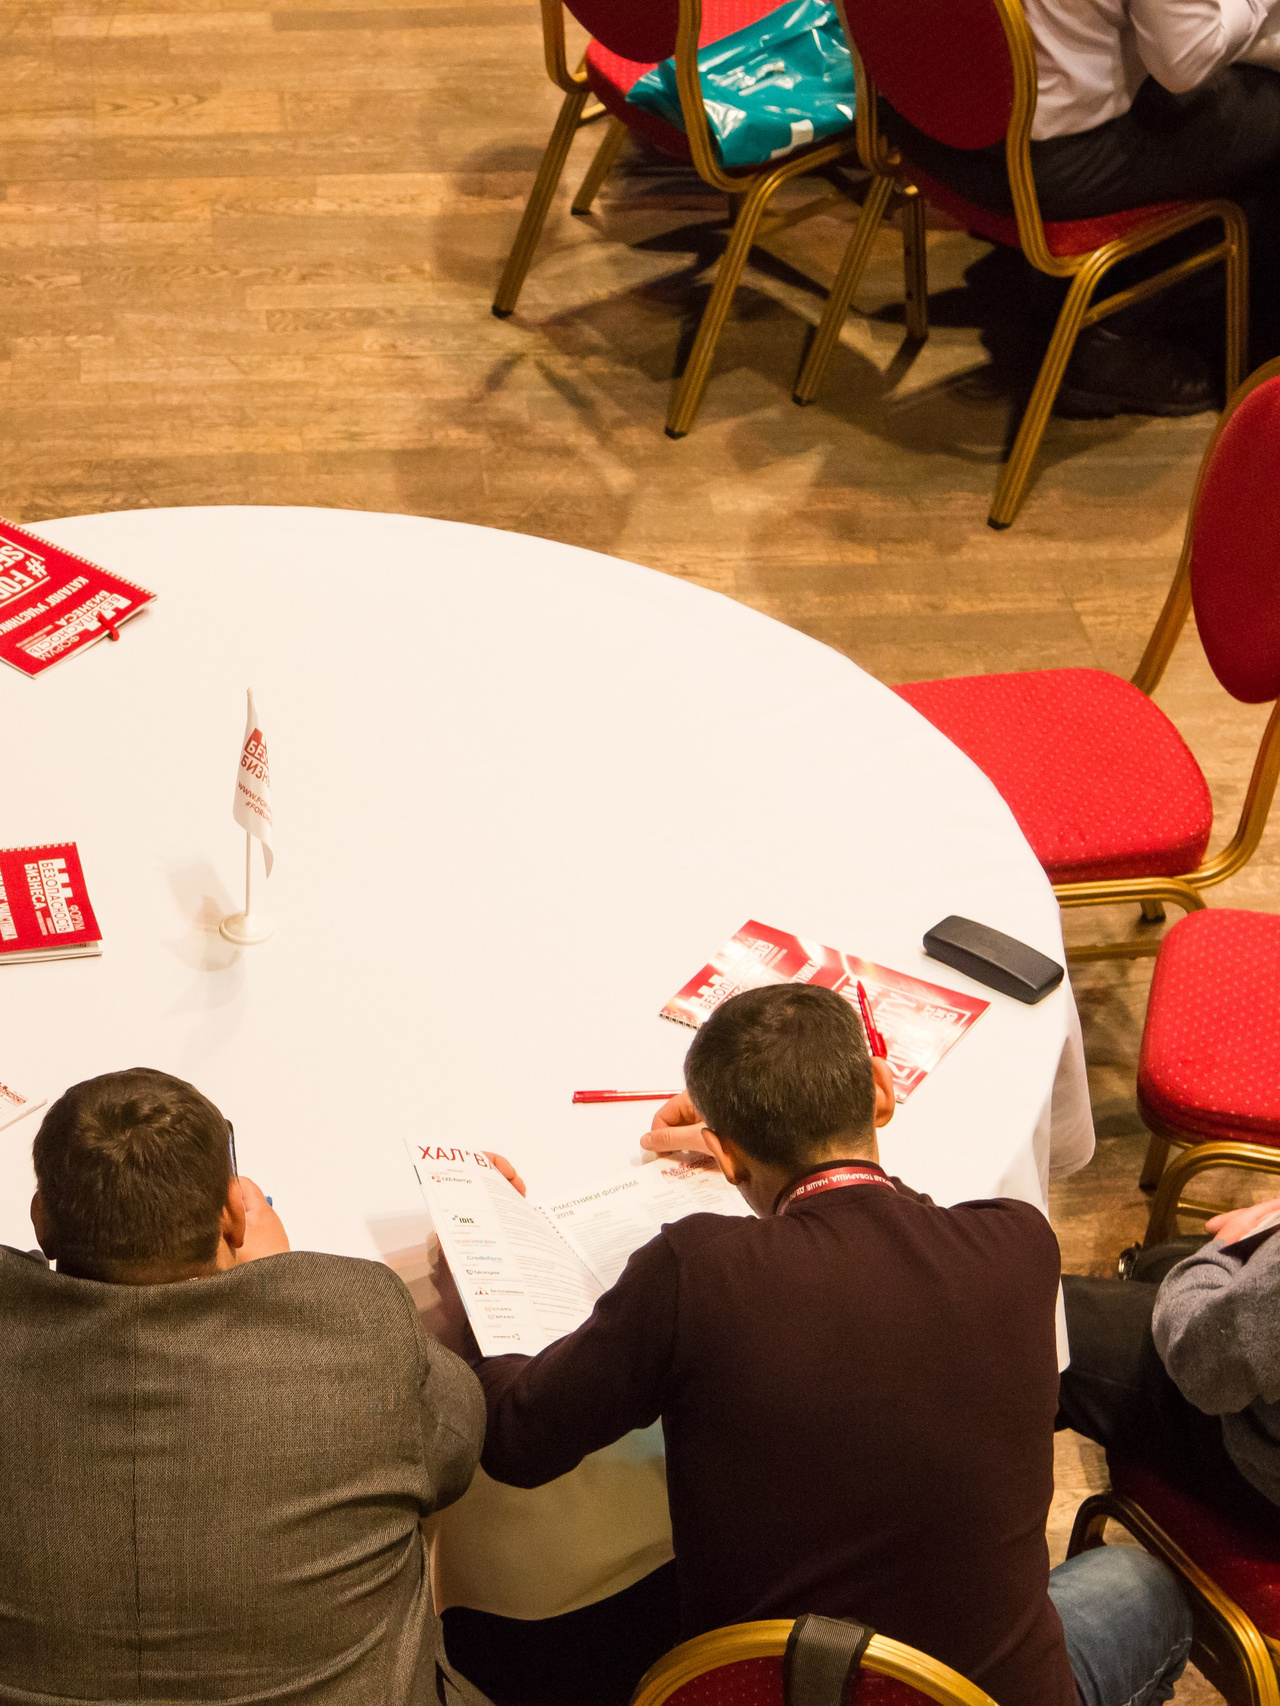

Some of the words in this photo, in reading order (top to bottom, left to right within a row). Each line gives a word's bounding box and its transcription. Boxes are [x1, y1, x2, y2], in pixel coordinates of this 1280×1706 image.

[45, 576, 89, 607] КАТАЛОГ
[55, 590, 111, 626] БИЗНЕСА
[38, 635, 80, 661] ФОРУМ
[241, 754, 270, 787] БИЗН
[24, 863, 47, 910] БИЗНЕСА
[41, 861, 70, 932] БЕЗОПАСНОСТЬ
[550, 1192, 601, 1212] УЧАСТНИКИ
[601, 1179, 639, 1196] ФОРУМА
[806, 1178, 828, 1191] НАШЕ
[556, 1209, 575, 1219] 2018
